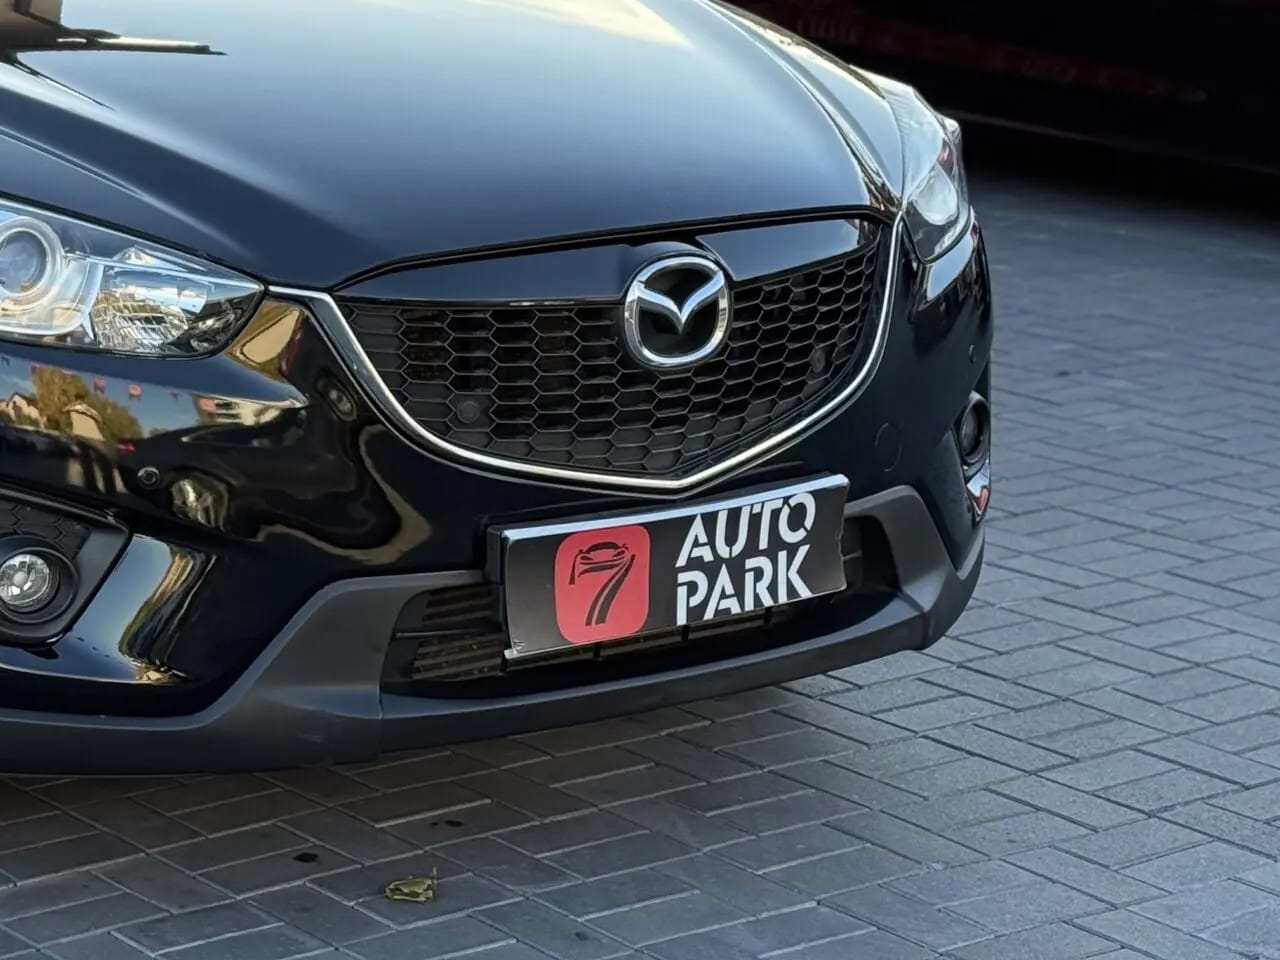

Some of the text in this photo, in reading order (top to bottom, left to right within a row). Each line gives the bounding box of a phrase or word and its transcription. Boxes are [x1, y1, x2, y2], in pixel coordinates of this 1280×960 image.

[675, 492, 816, 568] AUTO
[568, 541, 636, 627] 7
[676, 544, 813, 626] PARK
